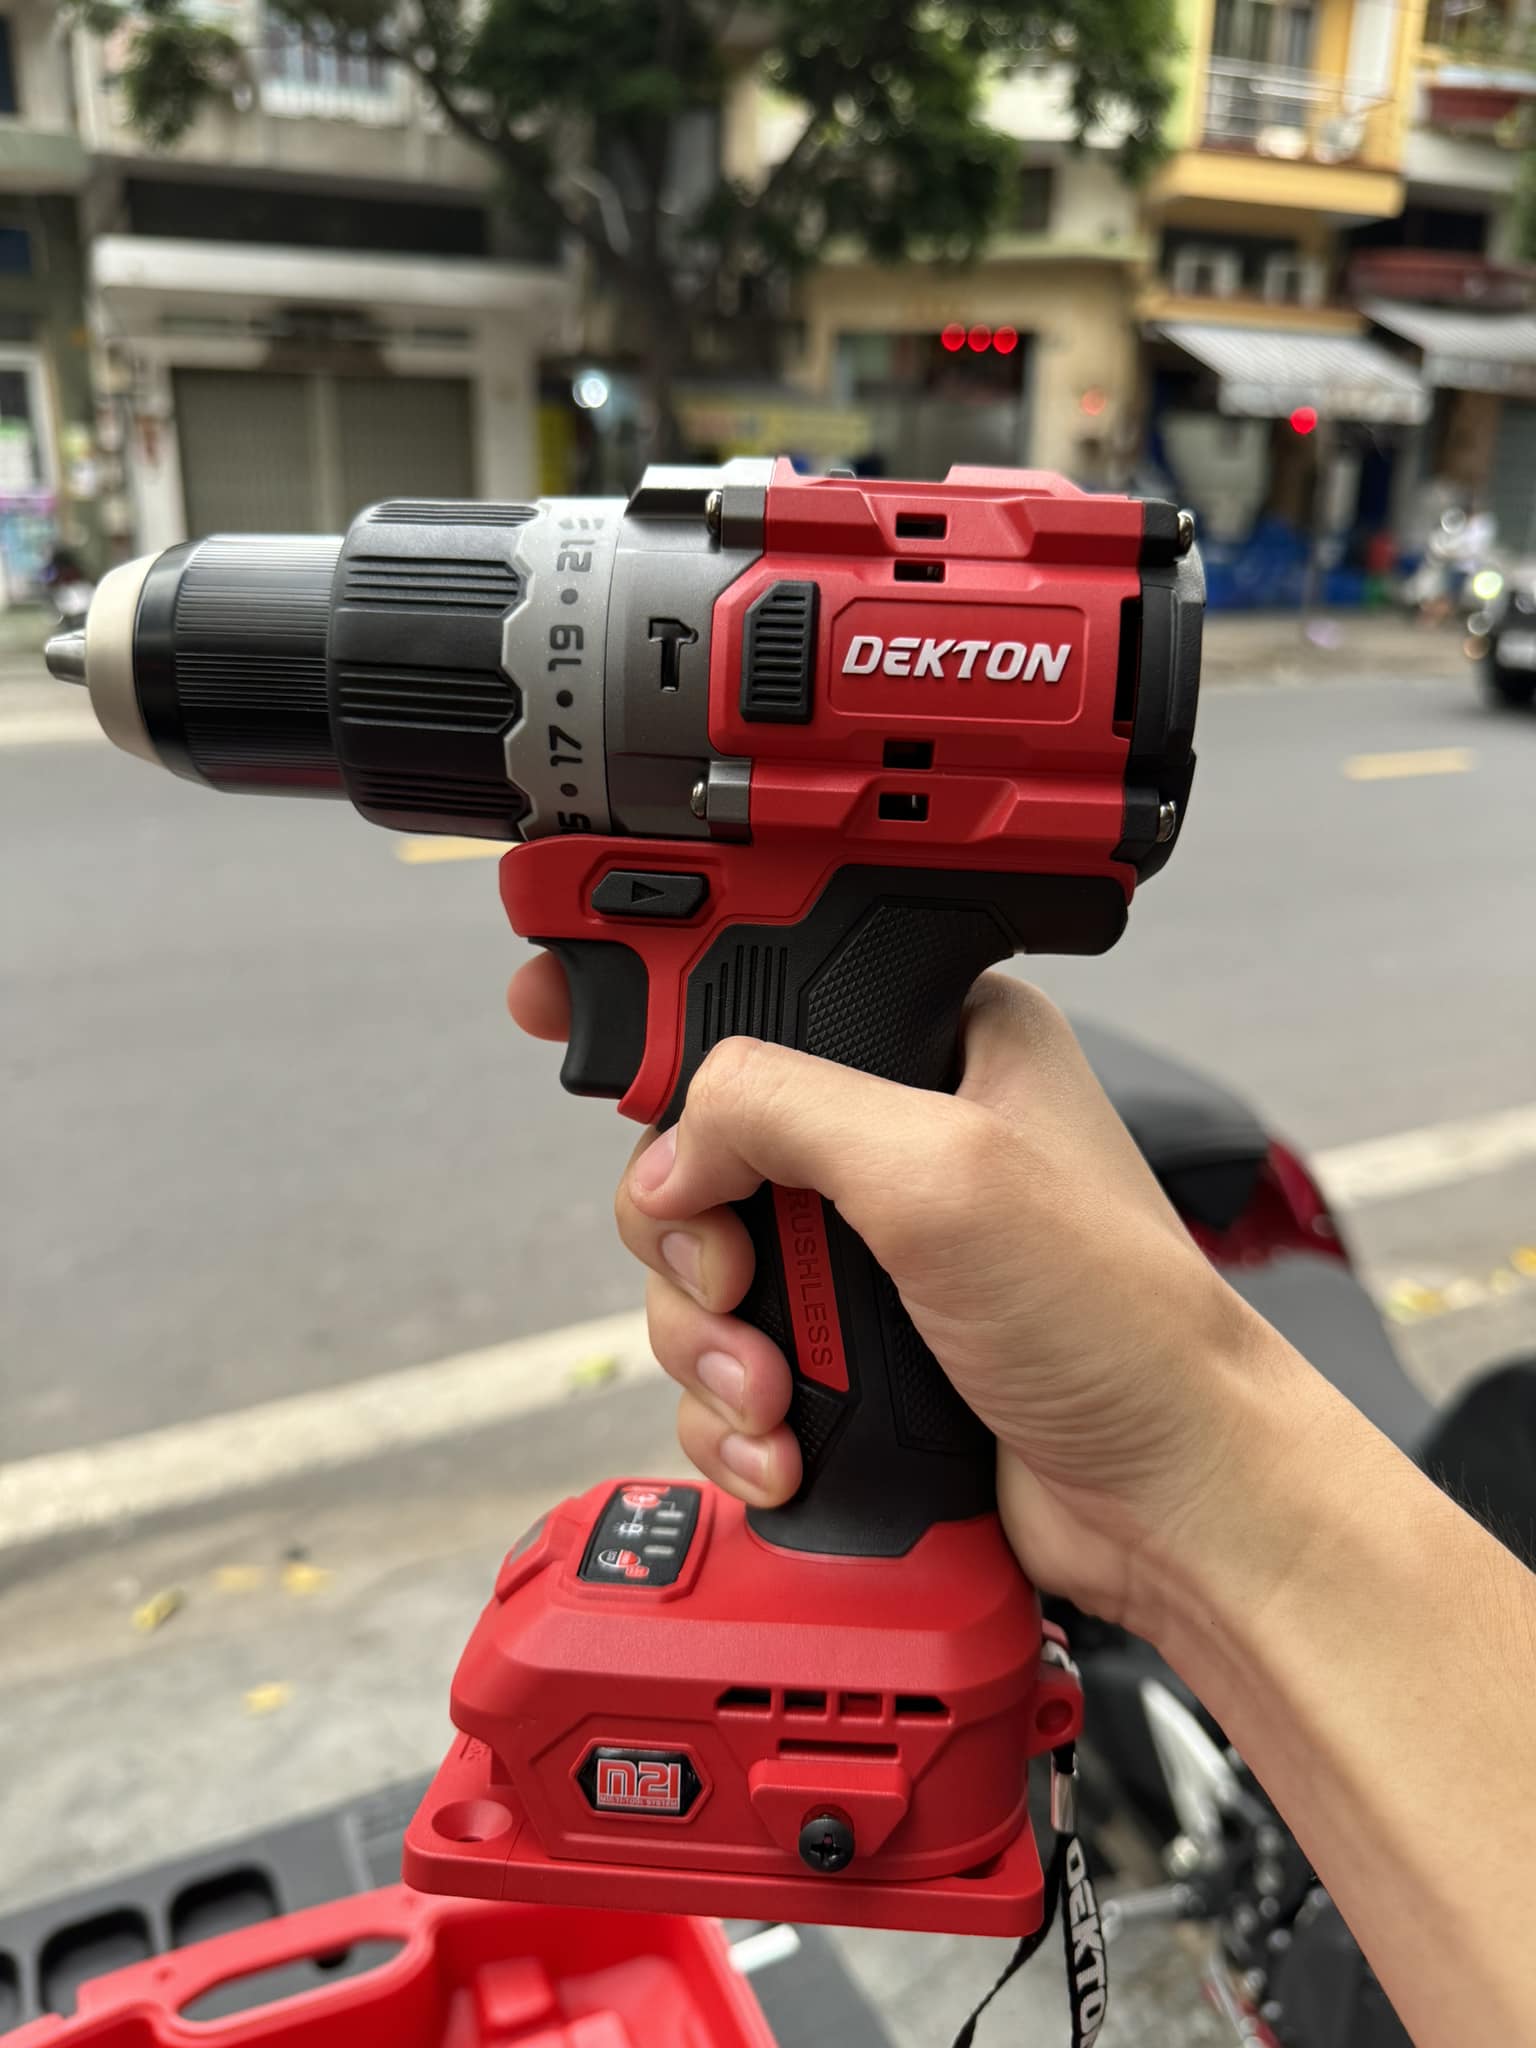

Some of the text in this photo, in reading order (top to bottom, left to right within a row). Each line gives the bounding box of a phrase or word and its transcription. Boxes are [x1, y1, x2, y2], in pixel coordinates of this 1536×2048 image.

[556, 539, 595, 573] 21
[548, 624, 584, 671] 19
[842, 635, 1072, 682] DEKTON
[548, 725, 583, 767] 17
[557, 811, 592, 834] 5
[785, 1189, 834, 1368] RUSHLESS
[597, 1758, 681, 1800] M21
[1065, 1836, 1106, 2048] DEKTO
